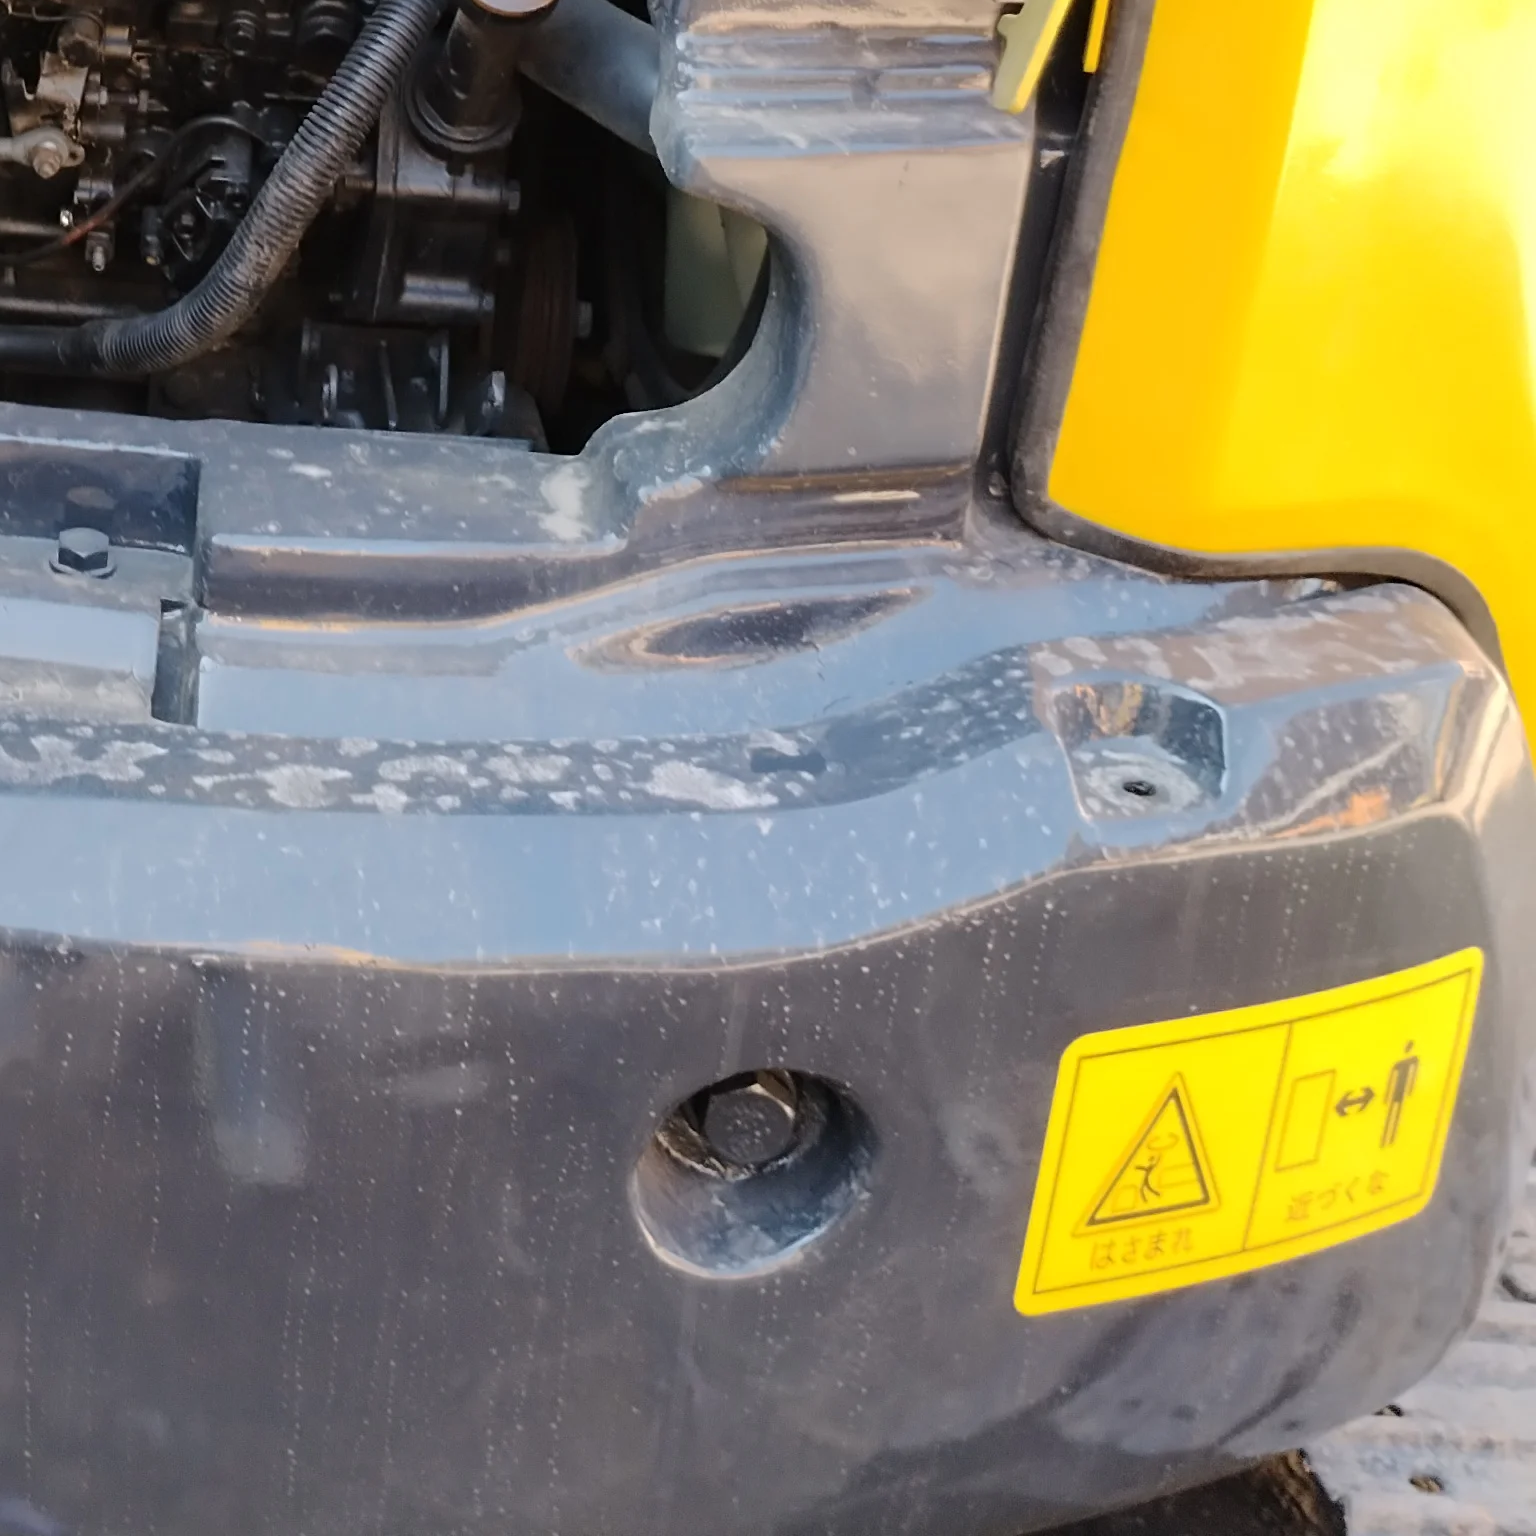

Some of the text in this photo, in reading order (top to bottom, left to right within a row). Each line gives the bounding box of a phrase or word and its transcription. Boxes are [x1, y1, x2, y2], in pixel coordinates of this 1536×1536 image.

[1284, 1170, 1390, 1223] 近づくな
[1090, 1228, 1193, 1271] はさまれ
